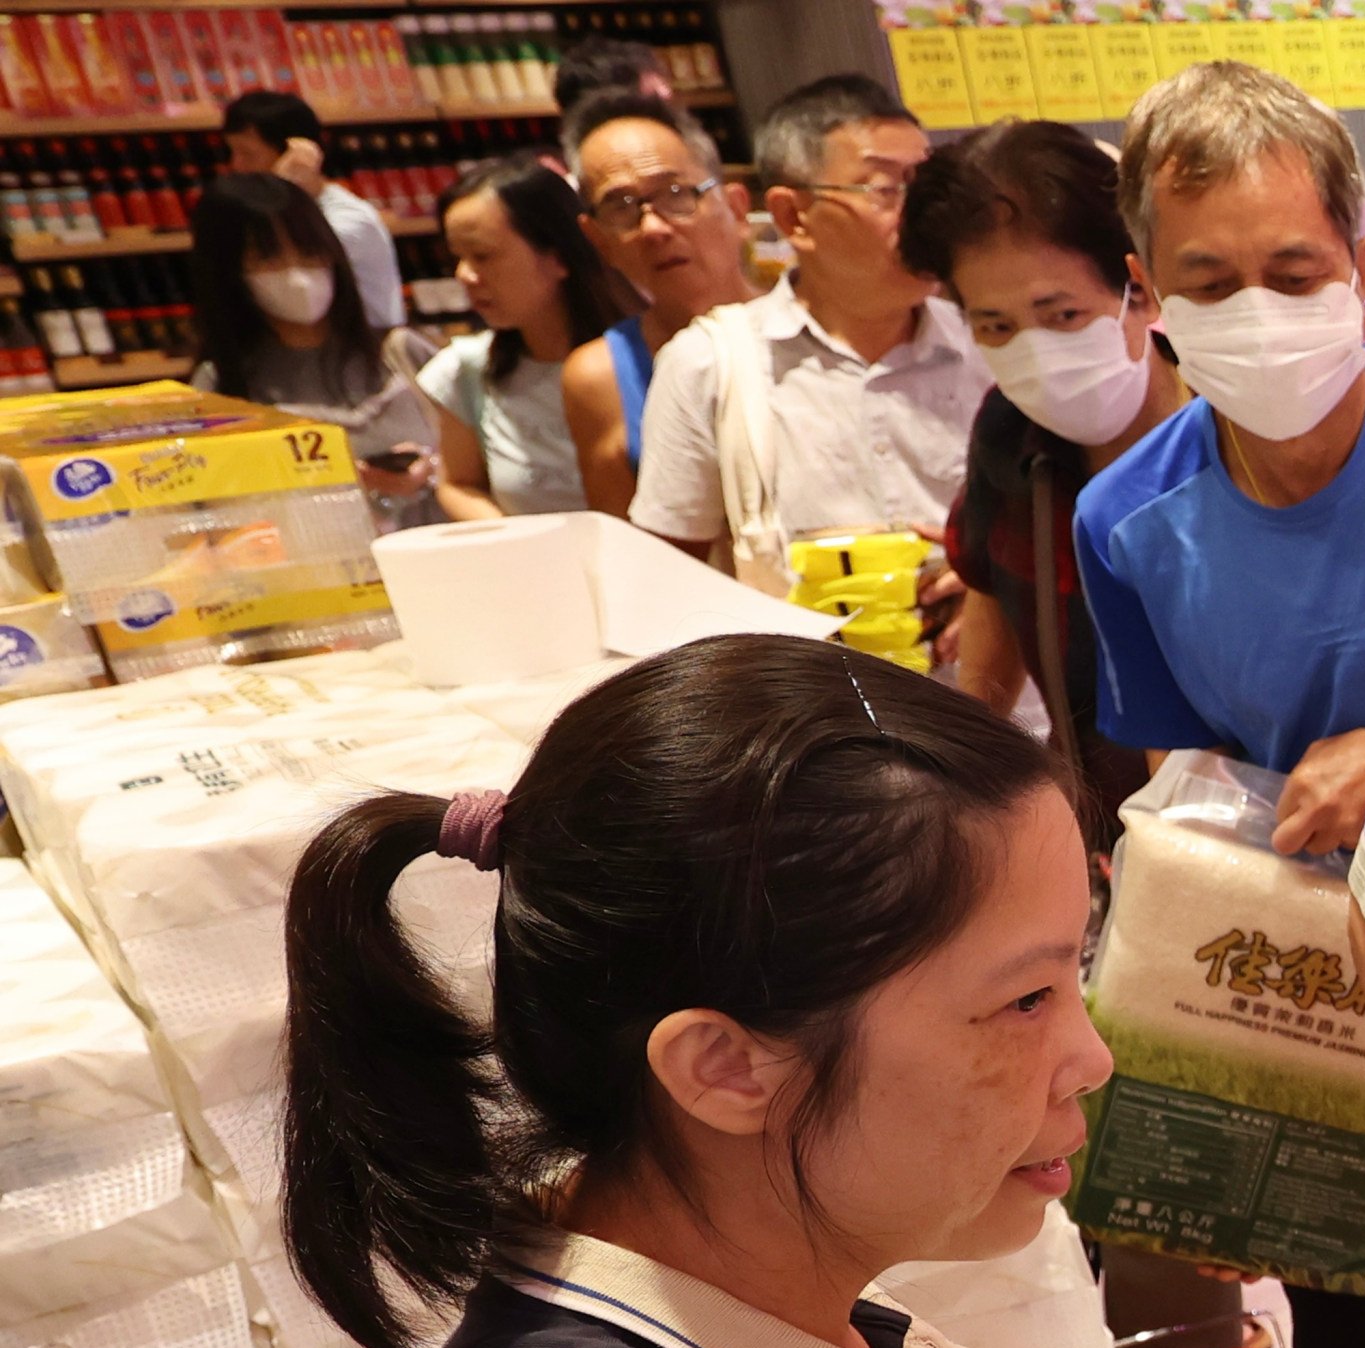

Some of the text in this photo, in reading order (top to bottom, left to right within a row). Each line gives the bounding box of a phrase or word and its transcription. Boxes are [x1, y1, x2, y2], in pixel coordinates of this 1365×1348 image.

[283, 430, 329, 463] 12
[1173, 1000, 1203, 1018] FULL
[1204, 1010, 1269, 1034] HAPPINESS
[1270, 1025, 1322, 1047] PREMIUM
[1107, 1210, 1140, 1230] Net
